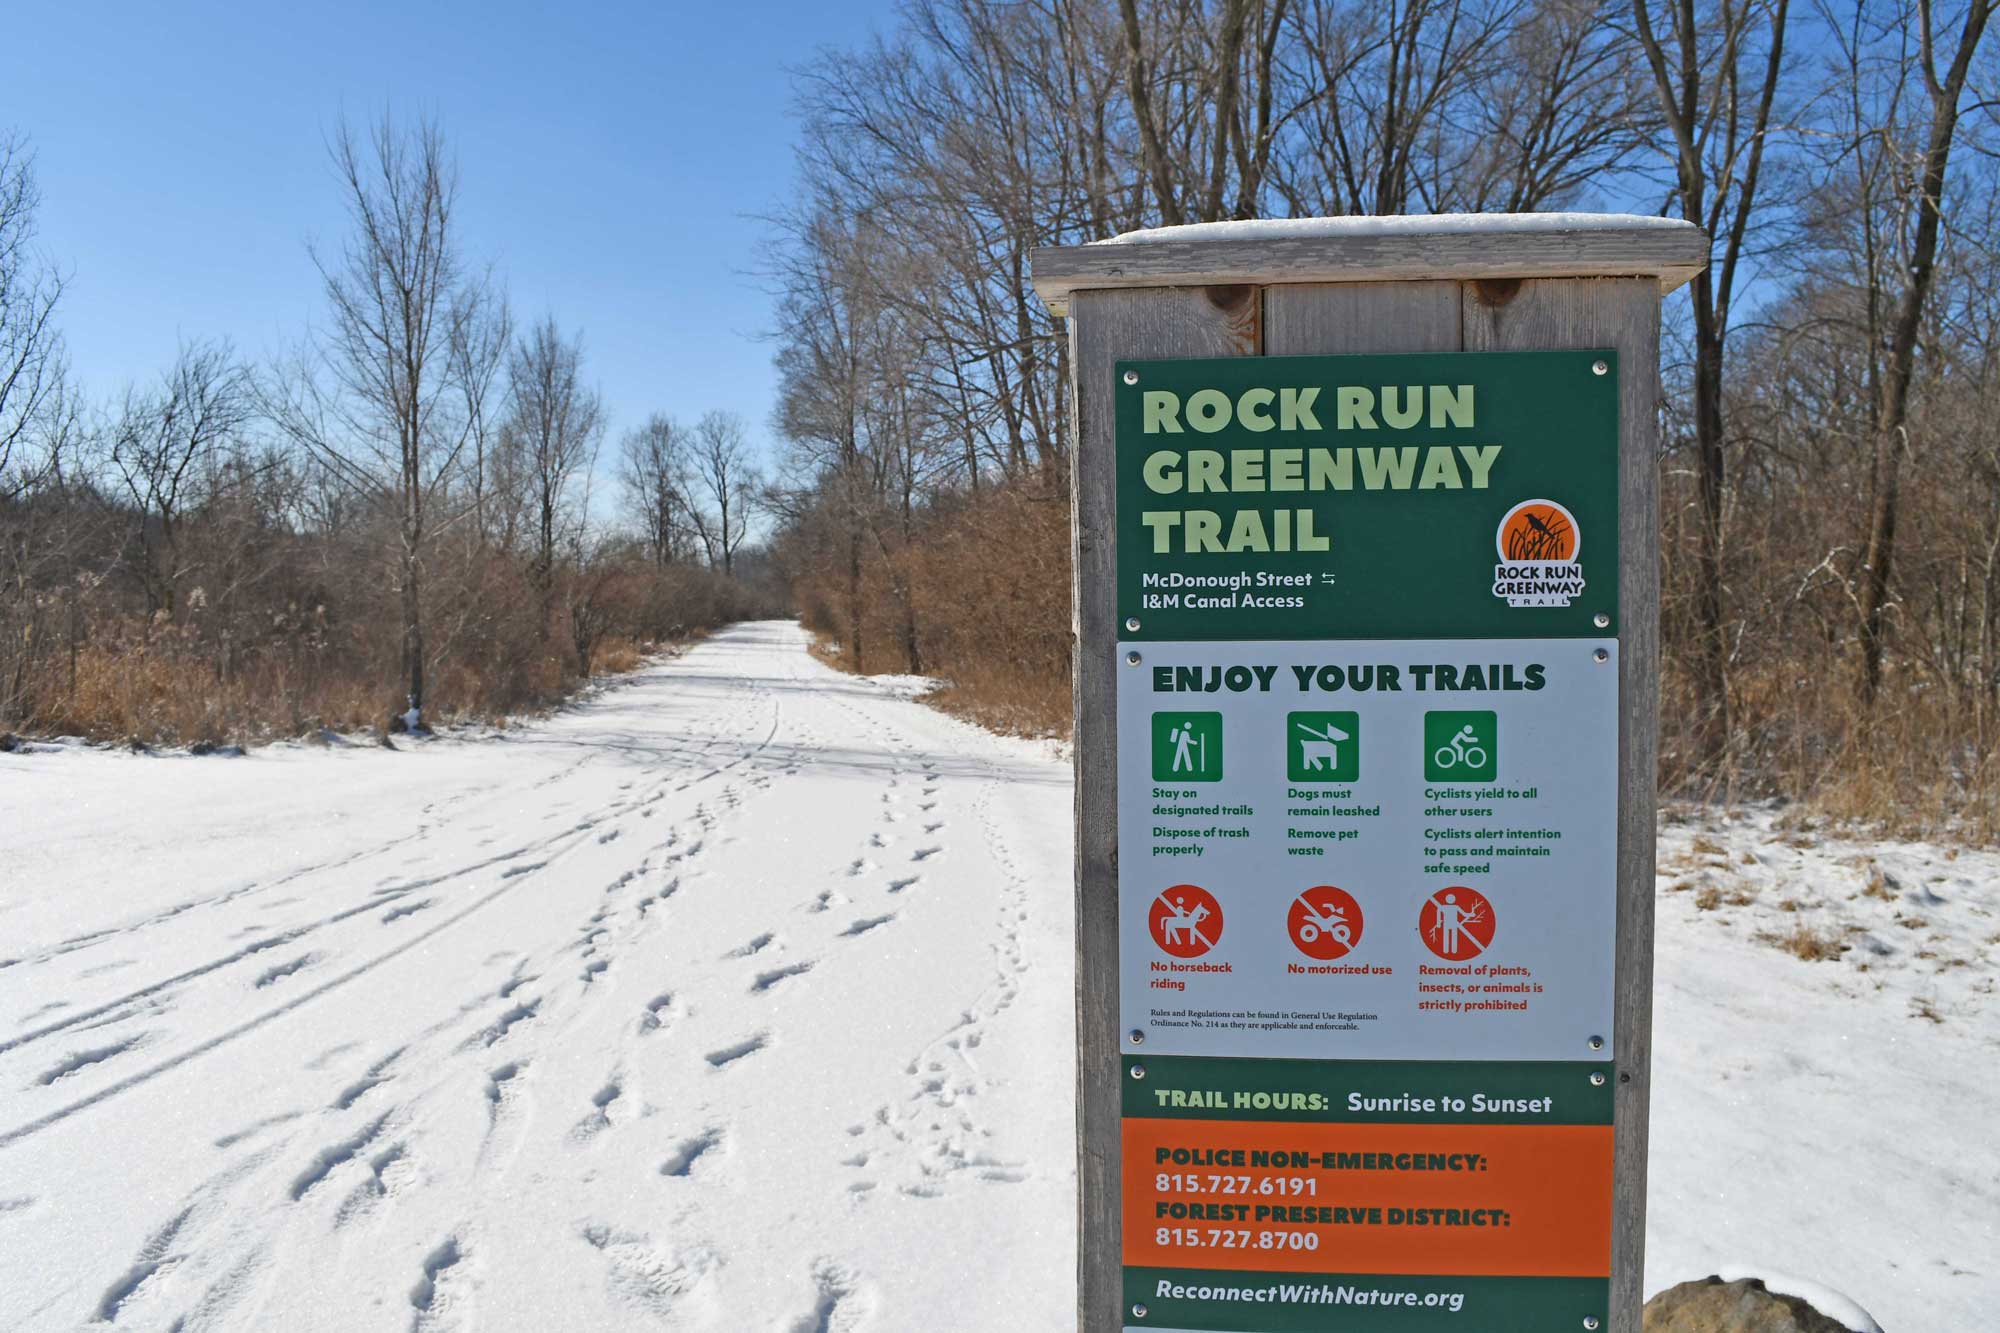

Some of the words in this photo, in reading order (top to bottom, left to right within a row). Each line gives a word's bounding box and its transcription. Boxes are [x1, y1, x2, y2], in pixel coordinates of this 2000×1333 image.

[1143, 388, 1322, 433] ROCK
[1337, 385, 1474, 429] RUN
[1143, 445, 1502, 494] GREENWAY
[1142, 509, 1329, 553] TRAIL
[1498, 566, 1540, 580] ROCK
[1545, 566, 1580, 579] RUN
[1143, 571, 1251, 590] McDonough
[1256, 572, 1312, 586] Street
[1495, 581, 1583, 595] GREENWAY
[1143, 594, 1178, 608] I&M
[1184, 593, 1236, 608] Canal
[1241, 594, 1303, 607] Access
[1510, 598, 1569, 606] TRAIL
[1153, 666, 1278, 692] ENJOY
[1291, 665, 1402, 691] YOUR
[1409, 664, 1545, 691] TRAILS
[1152, 788, 1179, 800] Stay
[1183, 790, 1197, 799] on
[1288, 788, 1319, 801] Dogs
[1323, 789, 1352, 799] must
[1425, 788, 1472, 801] Cyclists
[1475, 788, 1504, 801] yield
[1507, 789, 1519, 799] to
[1522, 788, 1537, 798] all
[1152, 804, 1219, 817] designated
[1222, 805, 1253, 815] trails
[1288, 806, 1330, 816] remain
[1333, 805, 1380, 816] leashed
[1424, 806, 1457, 816] other
[1460, 808, 1492, 817] users
[1153, 827, 1200, 839] Dispose
[1203, 827, 1216, 837] of
[1218, 827, 1249, 837] trash
[1288, 828, 1336, 838] Remove
[1339, 830, 1359, 841] pet
[1424, 828, 1471, 841] Cyclists
[1474, 828, 1504, 838] alert
[1507, 828, 1561, 839] intention
[1153, 844, 1203, 856] properly
[1288, 846, 1324, 856] waste
[1424, 846, 1437, 856] to
[1440, 848, 1467, 859] pass
[1470, 845, 1493, 856] and
[1496, 846, 1550, 856] maintain
[1424, 862, 1450, 873] safe
[1453, 862, 1490, 875] speed
[1151, 961, 1168, 972] No
[1171, 961, 1232, 972] horseback
[1288, 963, 1305, 974] No
[1308, 964, 1369, 974] motorized
[1372, 966, 1392, 975] use
[1419, 965, 1471, 975] Removal
[1474, 965, 1488, 975] of
[1490, 965, 1531, 978] plants,
[1151, 978, 1185, 991] riding
[1419, 982, 1464, 994] insects,
[1468, 984, 1480, 993] or
[1483, 982, 1530, 992] animals
[1533, 982, 1543, 993] is
[1419, 1000, 1461, 1012] strictly
[1465, 1000, 1527, 1012] prohibited
[1151, 1009, 1170, 1017] Rules
[1171, 1010, 1185, 1018] and
[1188, 1009, 1230, 1020] Regulations
[1247, 1010, 1256, 1019] be
[1258, 1010, 1279, 1019] found
[1282, 1011, 1289, 1020] in
[1291, 1011, 1320, 1020] General
[1322, 1011, 1336, 1020] Use
[1338, 1011, 1377, 1022] Regulation
[1151, 1019, 1188, 1028] Ordinance
[1191, 1019, 1203, 1028] No.
[1206, 1020, 1219, 1028] 214
[1230, 1020, 1245, 1031] they
[1261, 1021, 1298, 1032] applicable
[1300, 1021, 1313, 1030] and
[1315, 1022, 1359, 1031] enforceable.
[1155, 1090, 1228, 1108] TRAIL
[1234, 1092, 1328, 1110] HOURS:
[1348, 1093, 1435, 1112] Sunrise
[1442, 1096, 1465, 1112] to
[1472, 1094, 1552, 1112] Sunset
[1155, 1147, 1246, 1167] POLICE
[1251, 1150, 1487, 1171] NON-EMERGENCY:
[1156, 1174, 1316, 1196] 815.727.6191
[1156, 1202, 1250, 1221] FOREST
[1255, 1205, 1382, 1224] PRESERVE
[1388, 1208, 1510, 1226] DISTRICT:
[1156, 1228, 1318, 1250] 815.727.8700
[1156, 1280, 1464, 1311] ReconnectWithNature.org
